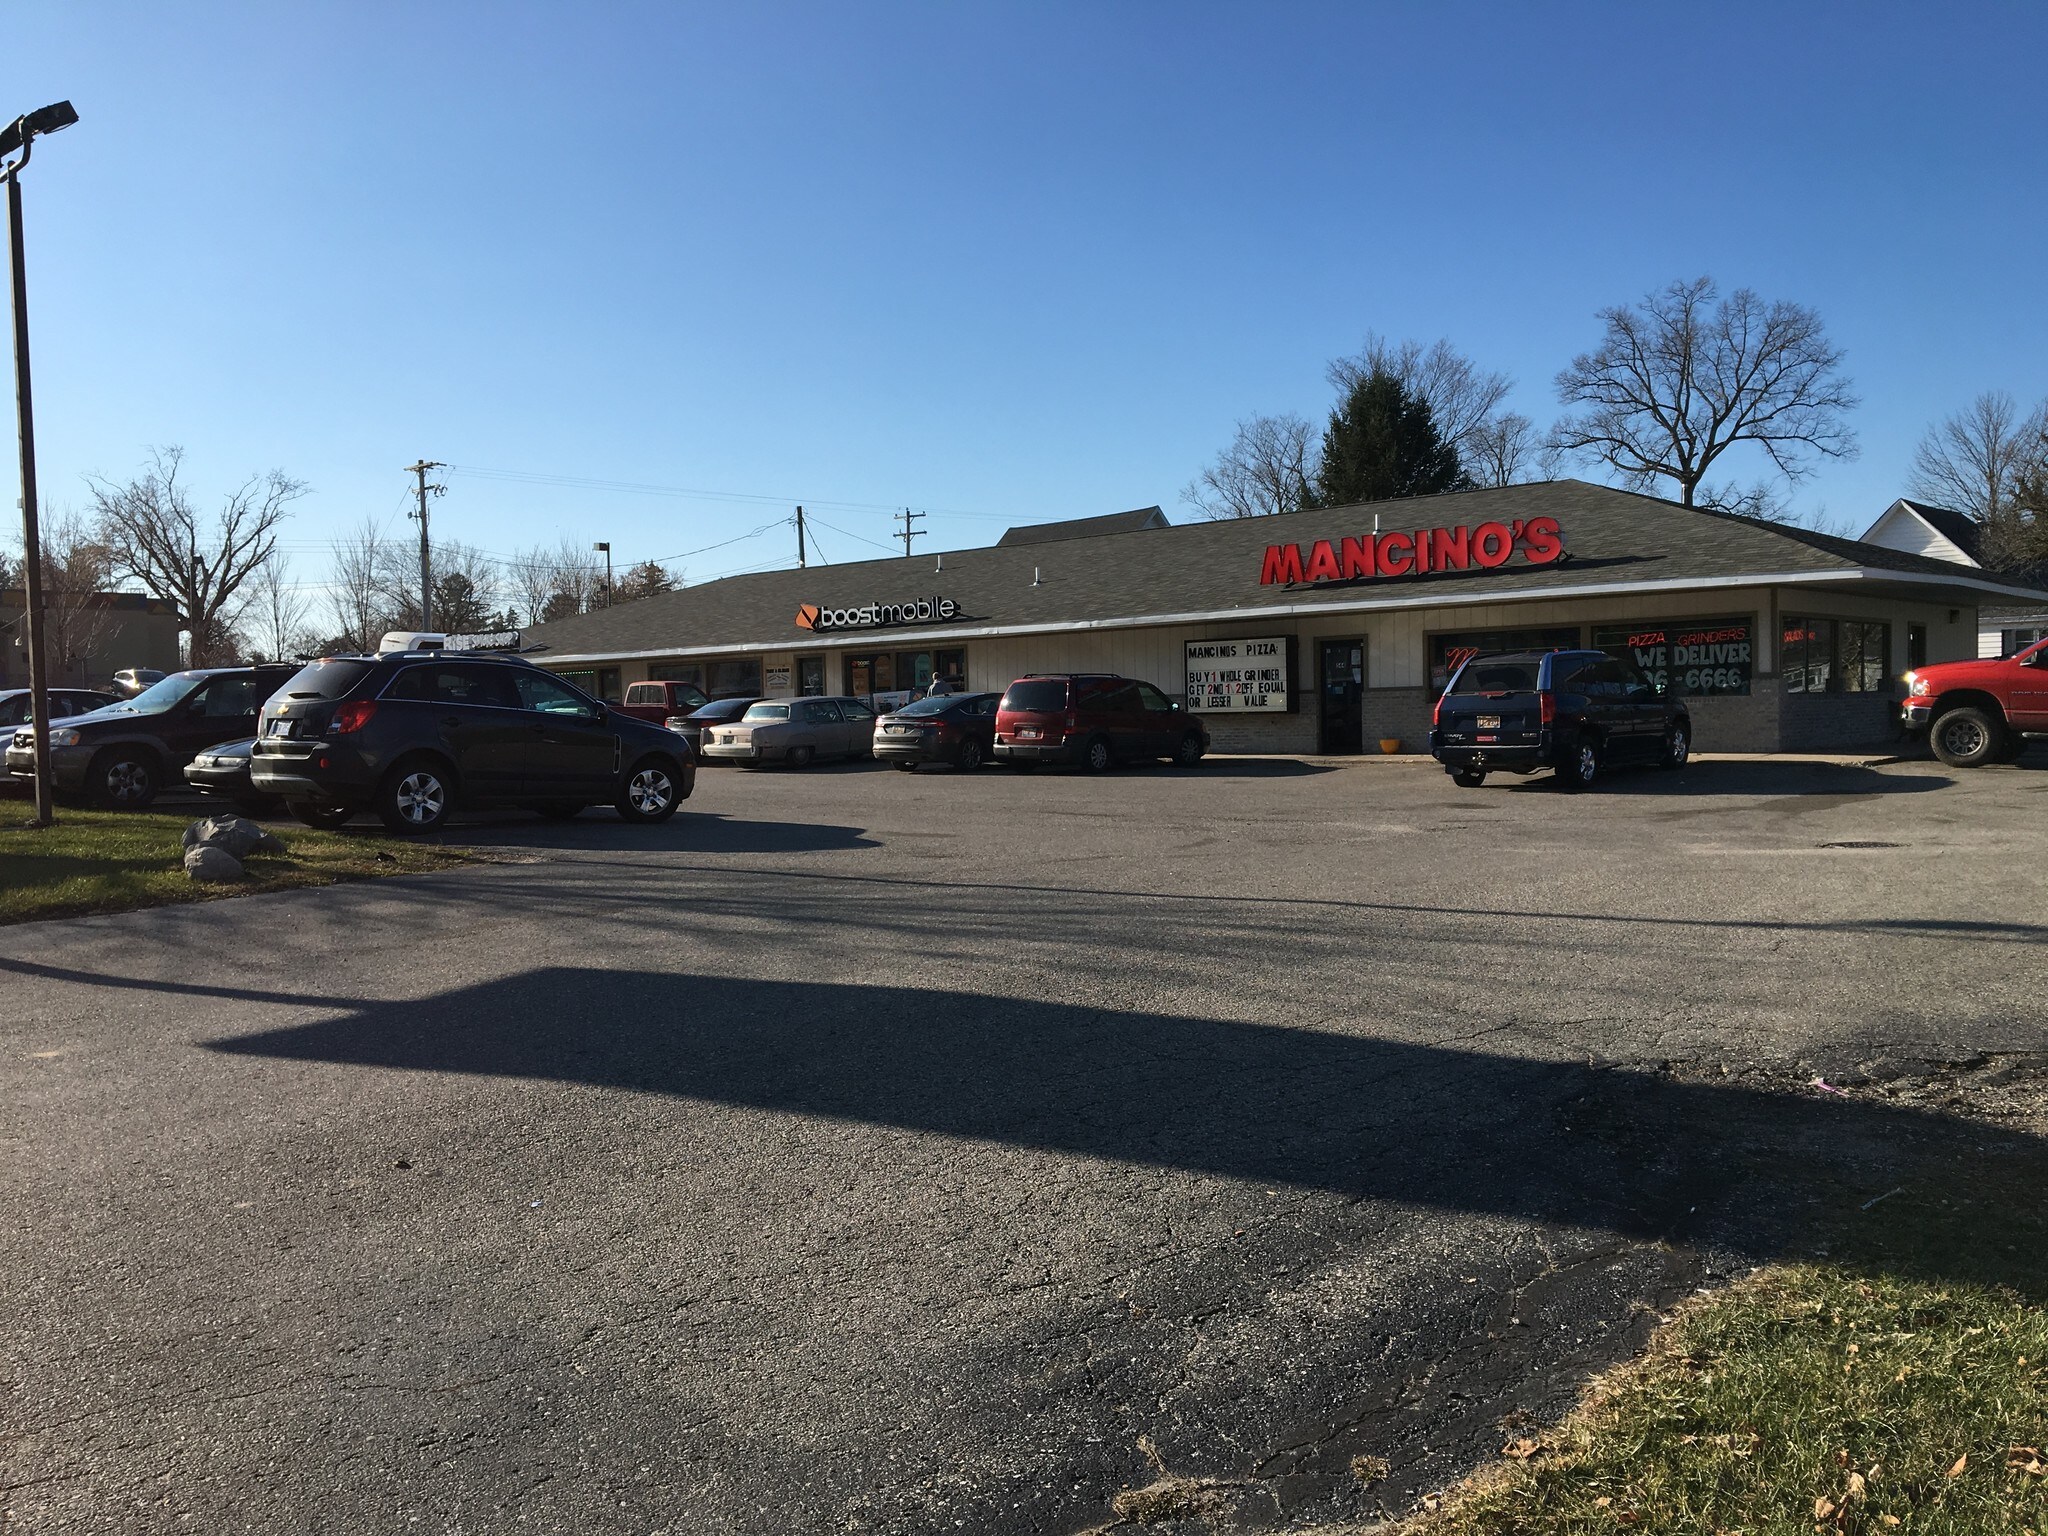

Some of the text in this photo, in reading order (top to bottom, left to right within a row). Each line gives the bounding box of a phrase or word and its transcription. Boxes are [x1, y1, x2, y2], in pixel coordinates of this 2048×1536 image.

[1260, 516, 1562, 585] MANCINO'S
[1628, 628, 1746, 647] PIZZA GRINDERS
[1634, 643, 1751, 667] WE DELIVER
[1189, 671, 1210, 683] BUY
[1219, 670, 1242, 682] WHOLE
[1244, 669, 1279, 681] GRINDER
[1188, 683, 1206, 696] GET
[1258, 682, 1285, 694] EQUAL
[1188, 695, 1268, 708] OR LESSER VALUE
